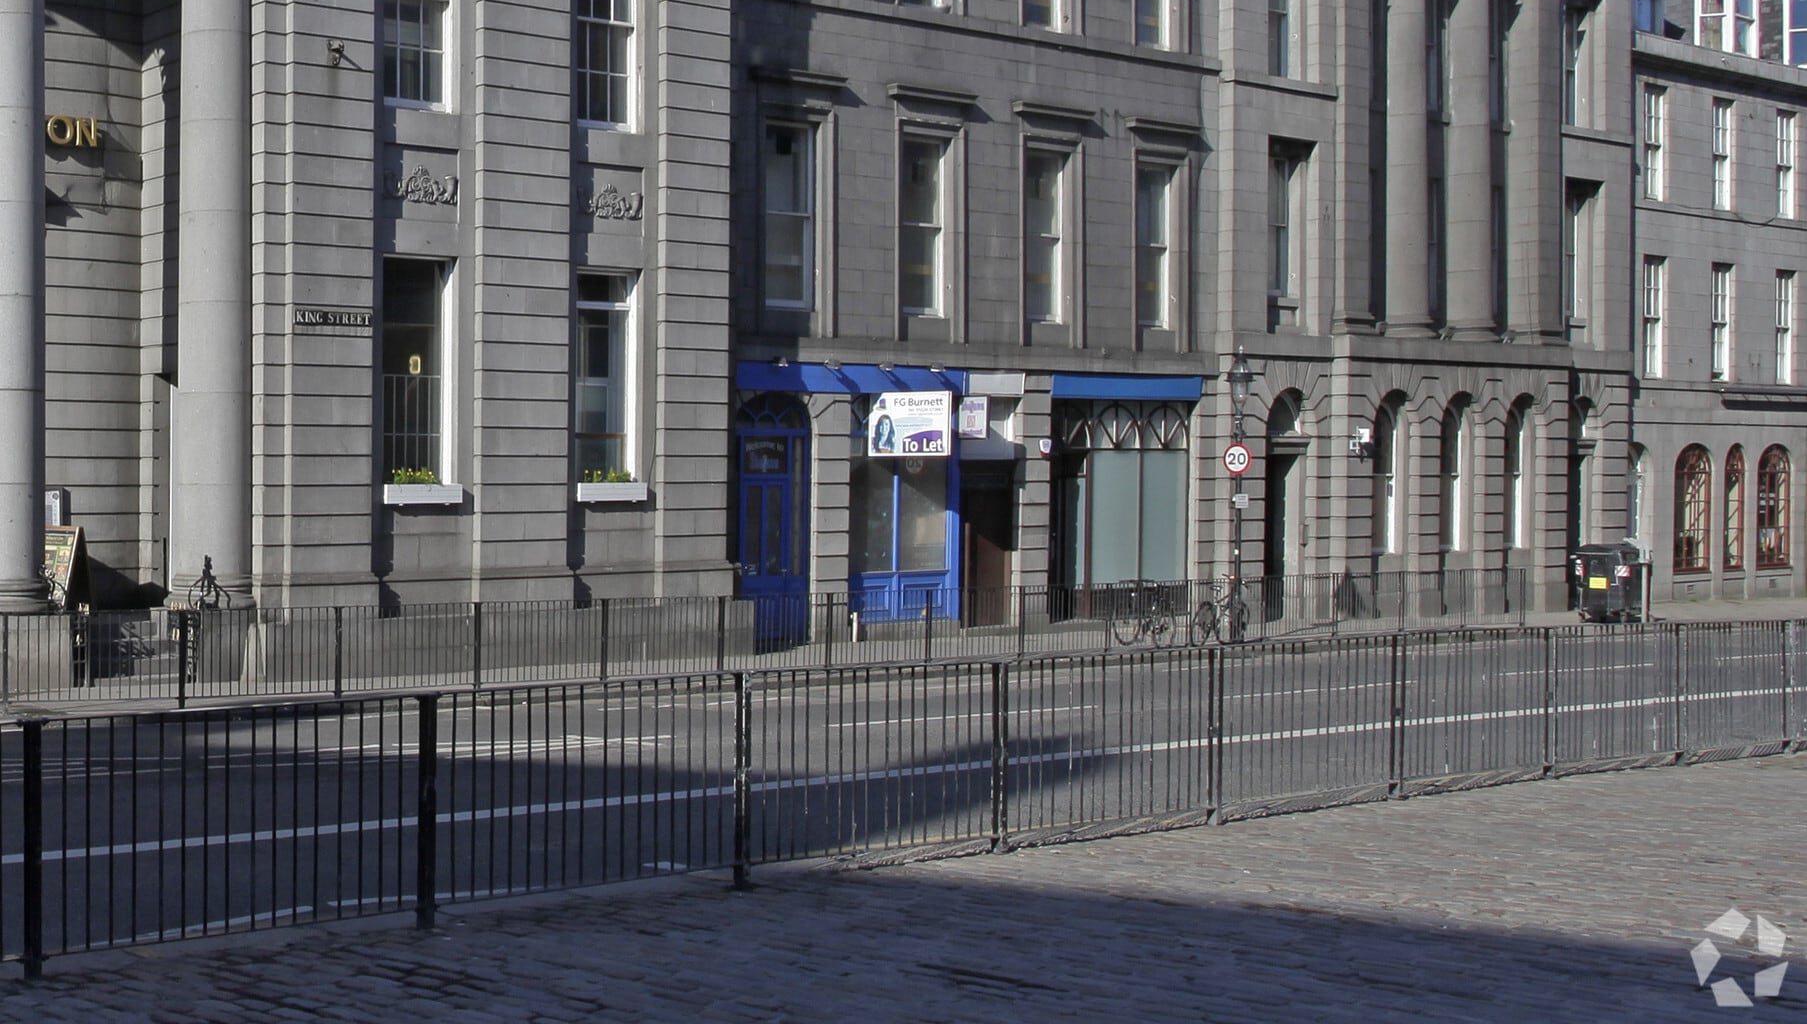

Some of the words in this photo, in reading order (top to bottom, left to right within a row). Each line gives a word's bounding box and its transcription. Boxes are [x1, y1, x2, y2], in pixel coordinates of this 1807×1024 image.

[47, 116, 97, 147] ON
[296, 311, 323, 323] KING
[328, 312, 371, 325] STREET
[893, 397, 906, 407] FG
[908, 397, 943, 407] Burnett
[903, 438, 919, 452] To
[923, 438, 943, 452] Let
[1228, 453, 1246, 465] 20
